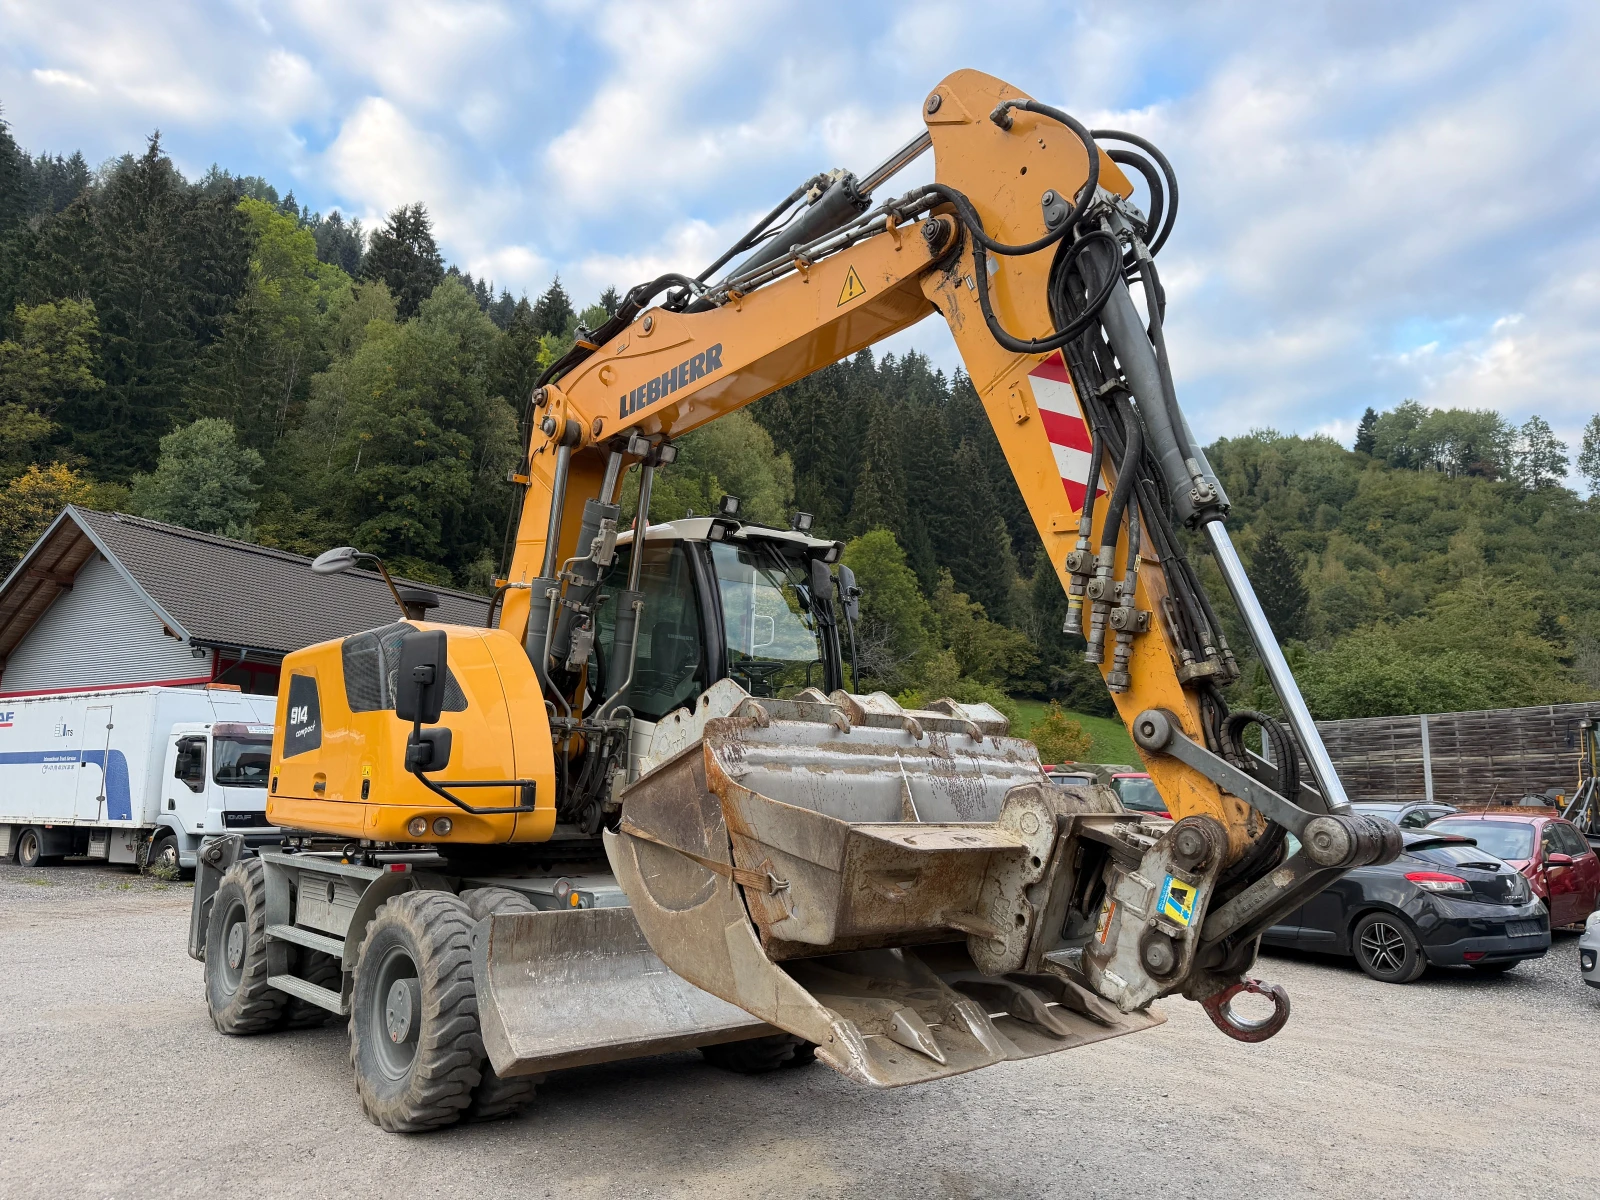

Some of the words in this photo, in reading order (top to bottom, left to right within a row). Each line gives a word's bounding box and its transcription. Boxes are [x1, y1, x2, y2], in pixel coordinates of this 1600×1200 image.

[619, 342, 723, 420] LIEBHERR
[290, 705, 308, 725] 914
[295, 720, 316, 738] compact
